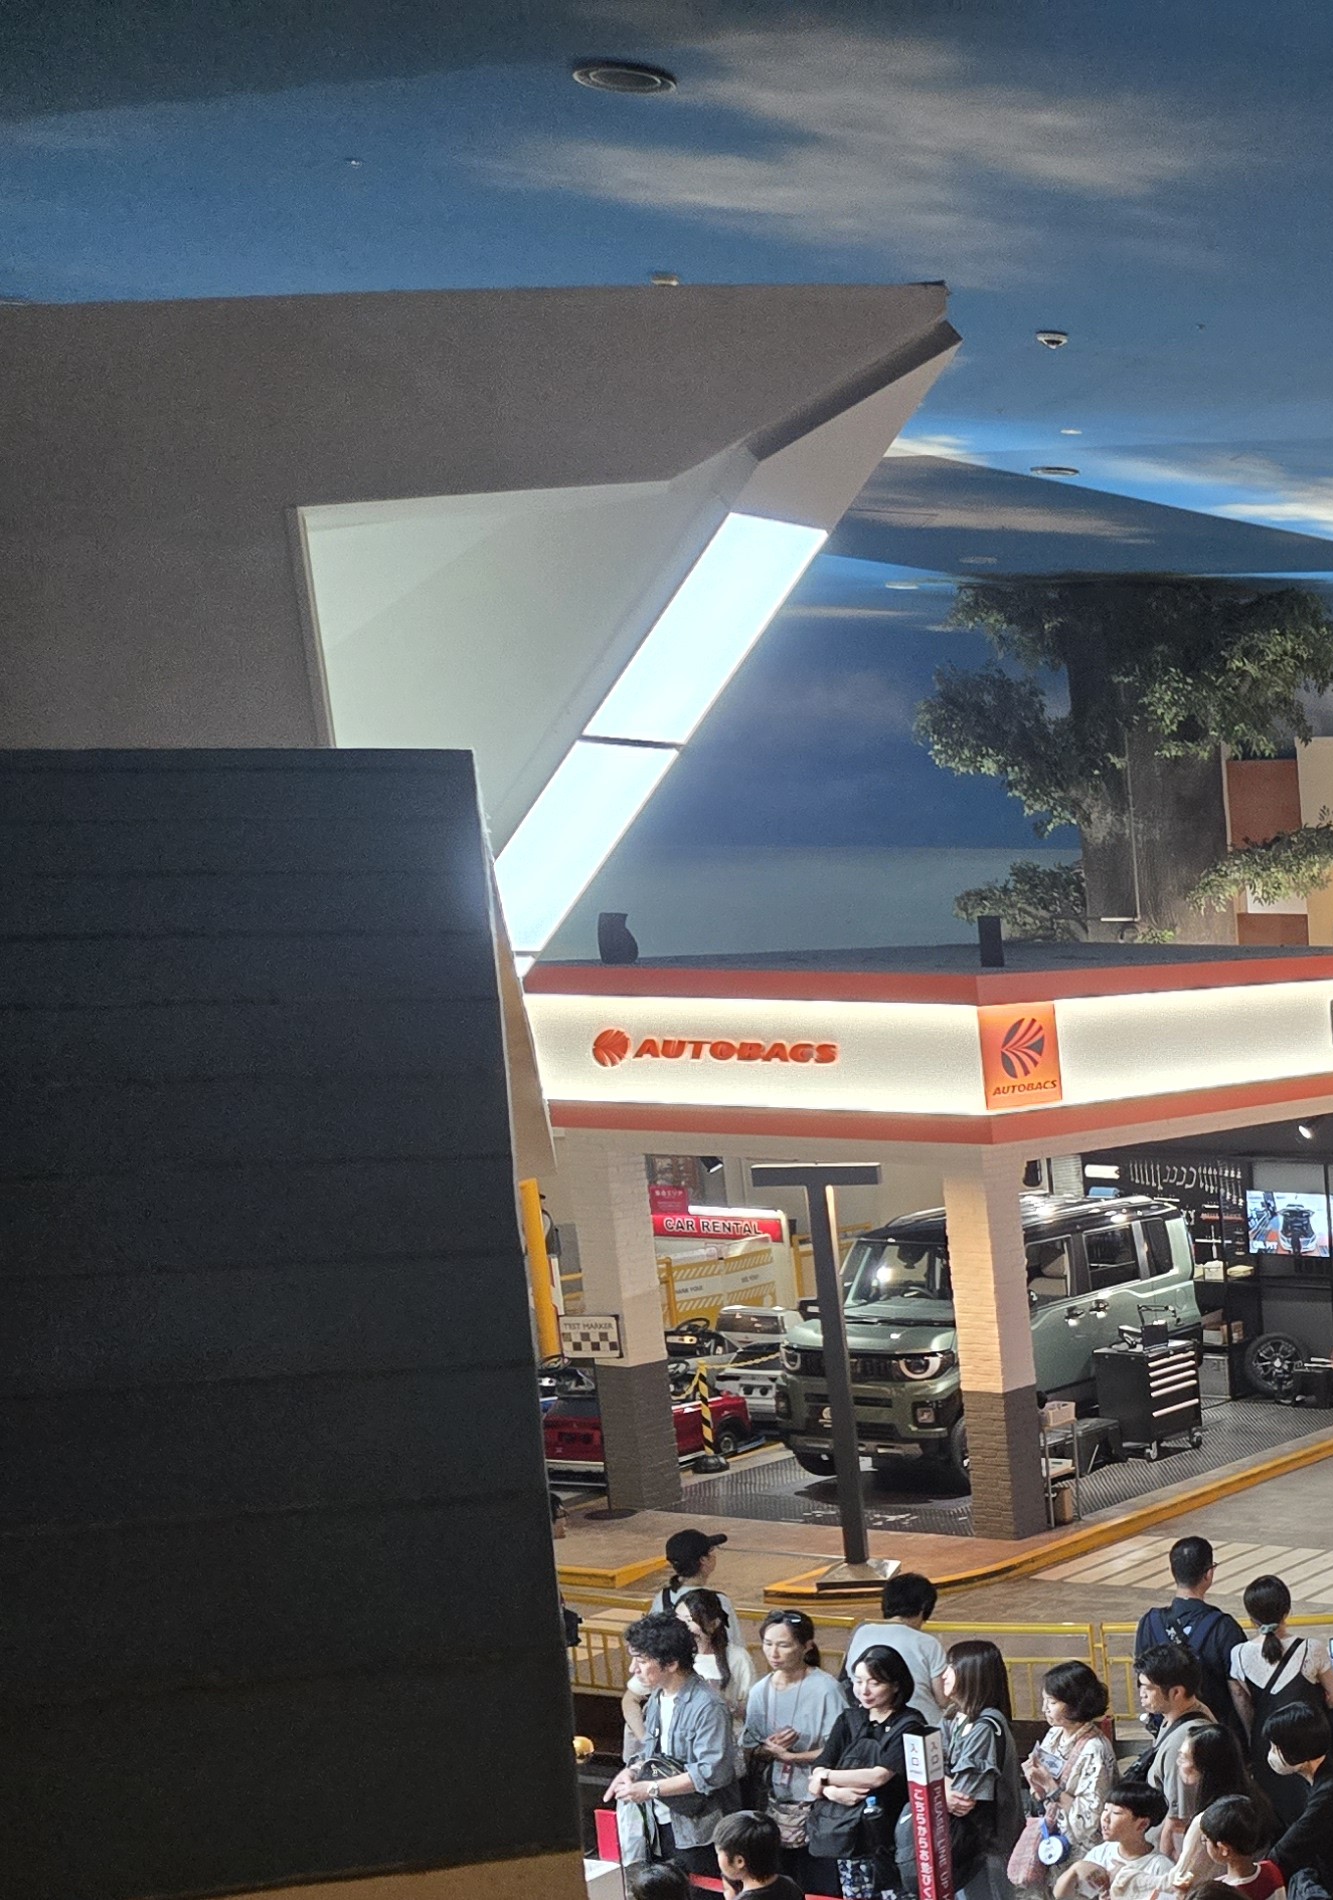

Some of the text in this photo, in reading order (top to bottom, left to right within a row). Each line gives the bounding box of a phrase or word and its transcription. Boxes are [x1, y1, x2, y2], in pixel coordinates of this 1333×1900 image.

[633, 1038, 838, 1063] AUTOBACS
[992, 1079, 1058, 1096] AUTOBACS
[664, 1218, 763, 1235] CAR RENTAL
[582, 1322, 614, 1331] MARKER
